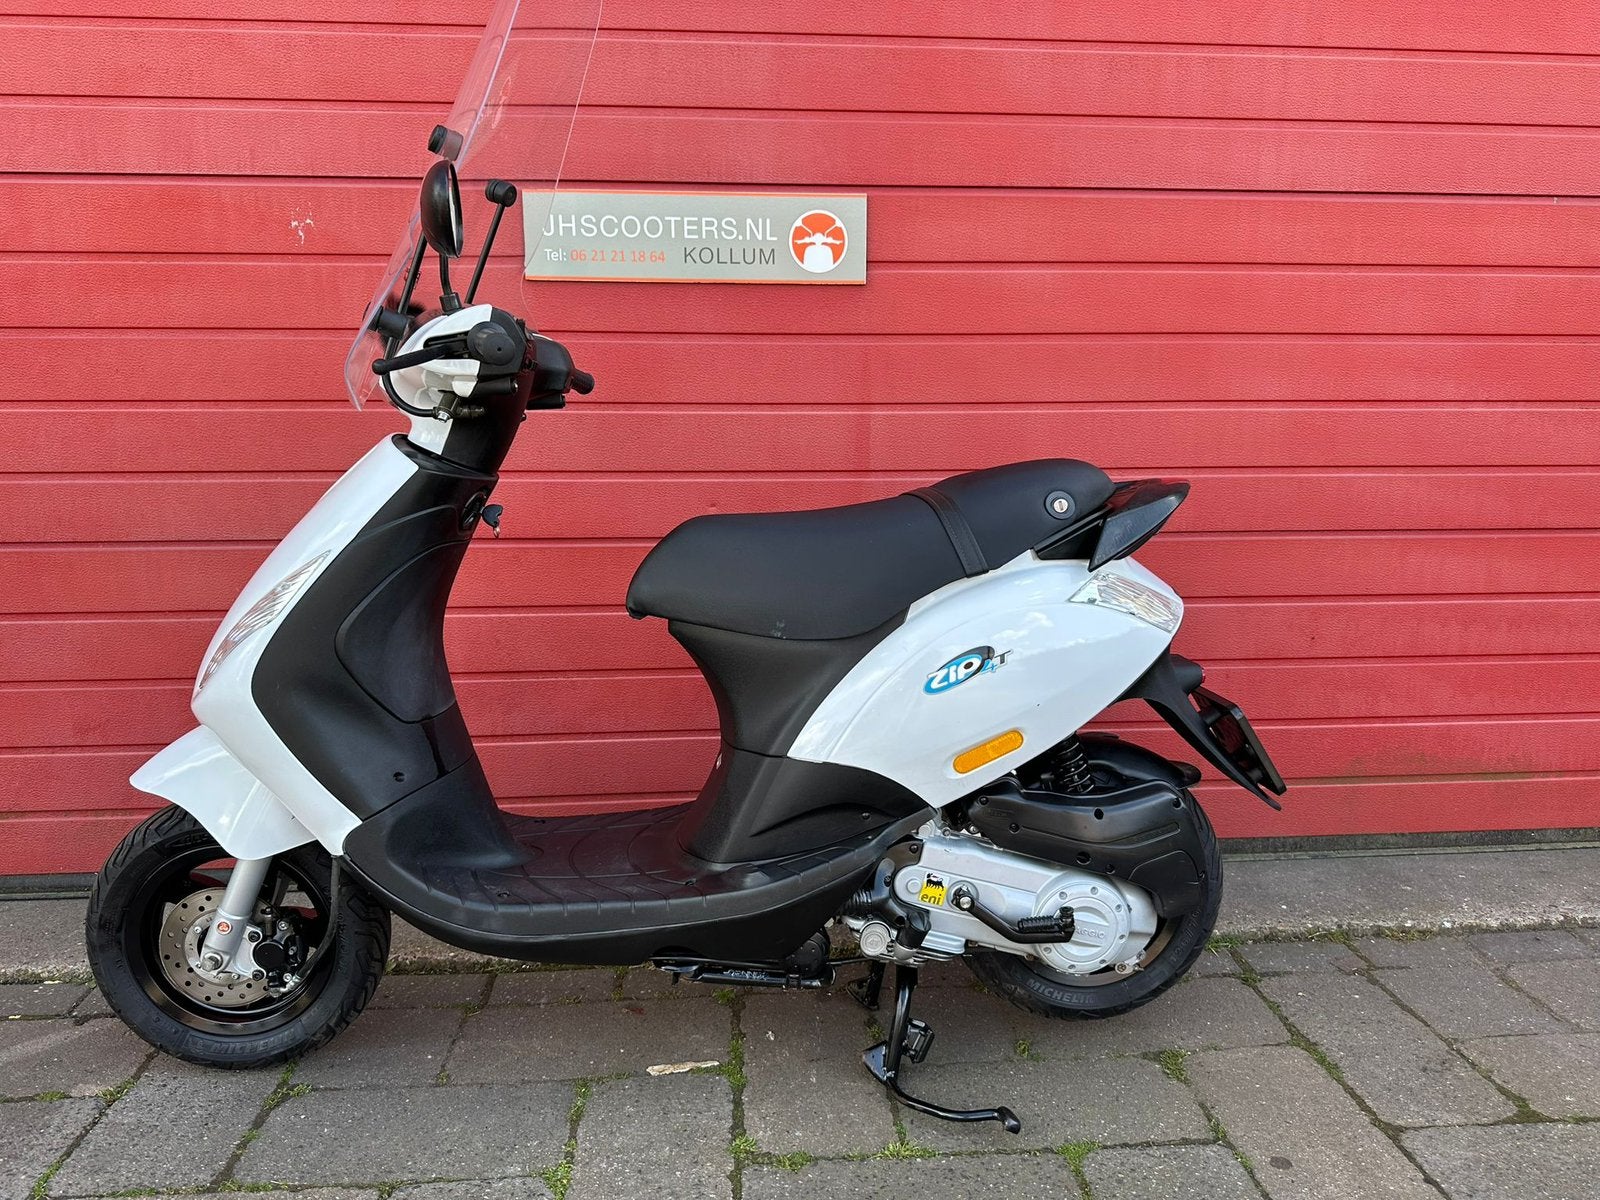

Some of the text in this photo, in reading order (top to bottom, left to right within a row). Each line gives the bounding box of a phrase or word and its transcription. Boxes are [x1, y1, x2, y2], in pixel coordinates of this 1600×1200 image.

[542, 213, 778, 241] JHSCOOTERS.NL
[544, 248, 666, 263] Tel: 06 21 21 18 64
[684, 247, 775, 265] KOLLUM
[921, 893, 942, 906] eni
